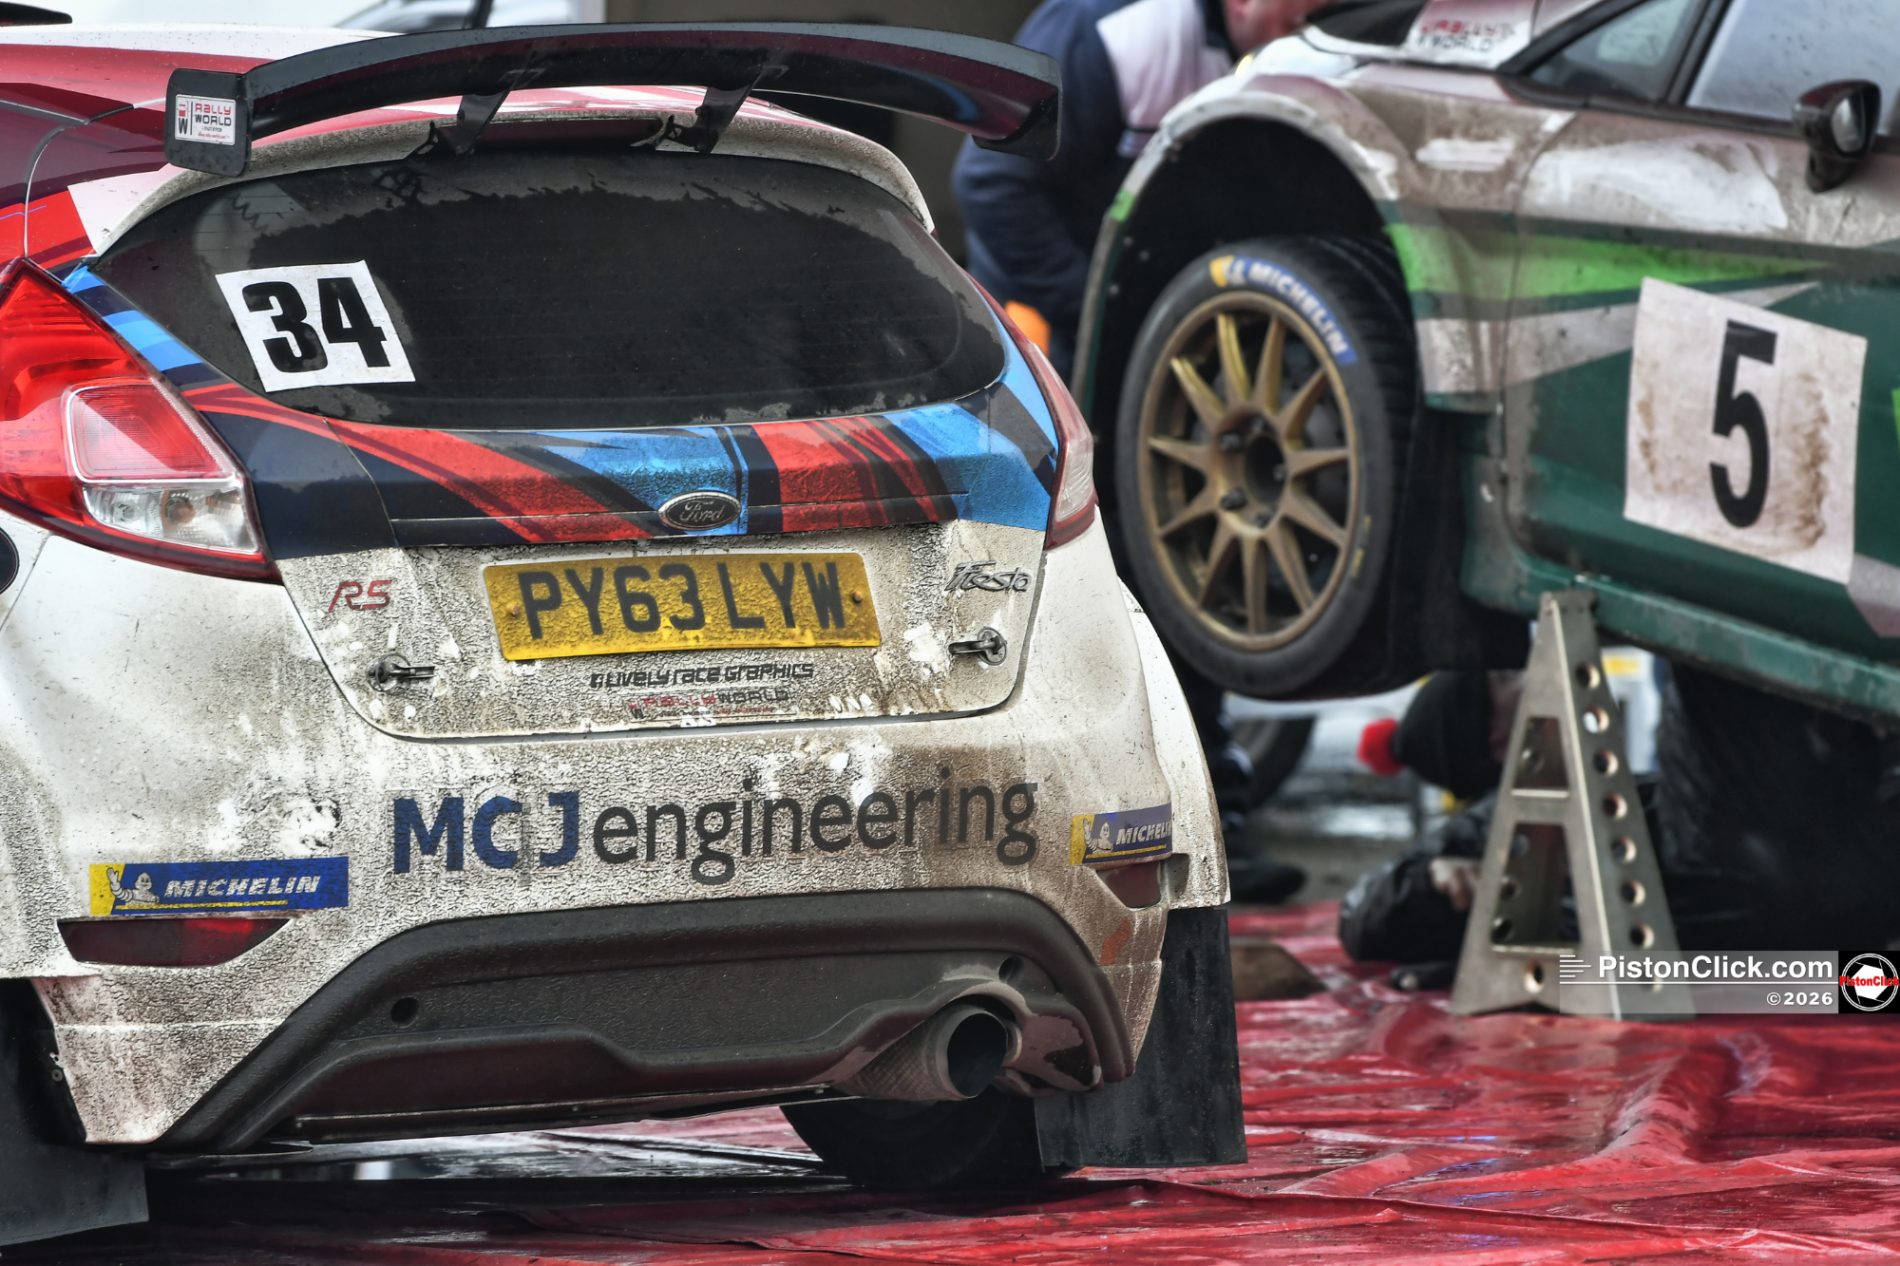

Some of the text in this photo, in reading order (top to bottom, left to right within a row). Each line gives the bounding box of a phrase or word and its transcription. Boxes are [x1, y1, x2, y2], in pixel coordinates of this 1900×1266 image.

[195, 114, 231, 126] WORLD
[242, 277, 391, 373] 34
[1249, 261, 1350, 355] MICHELIN
[1709, 319, 1778, 529] 5
[328, 580, 393, 613] RS
[517, 561, 846, 640] PY63 LYW
[164, 875, 321, 898] MICHELIN
